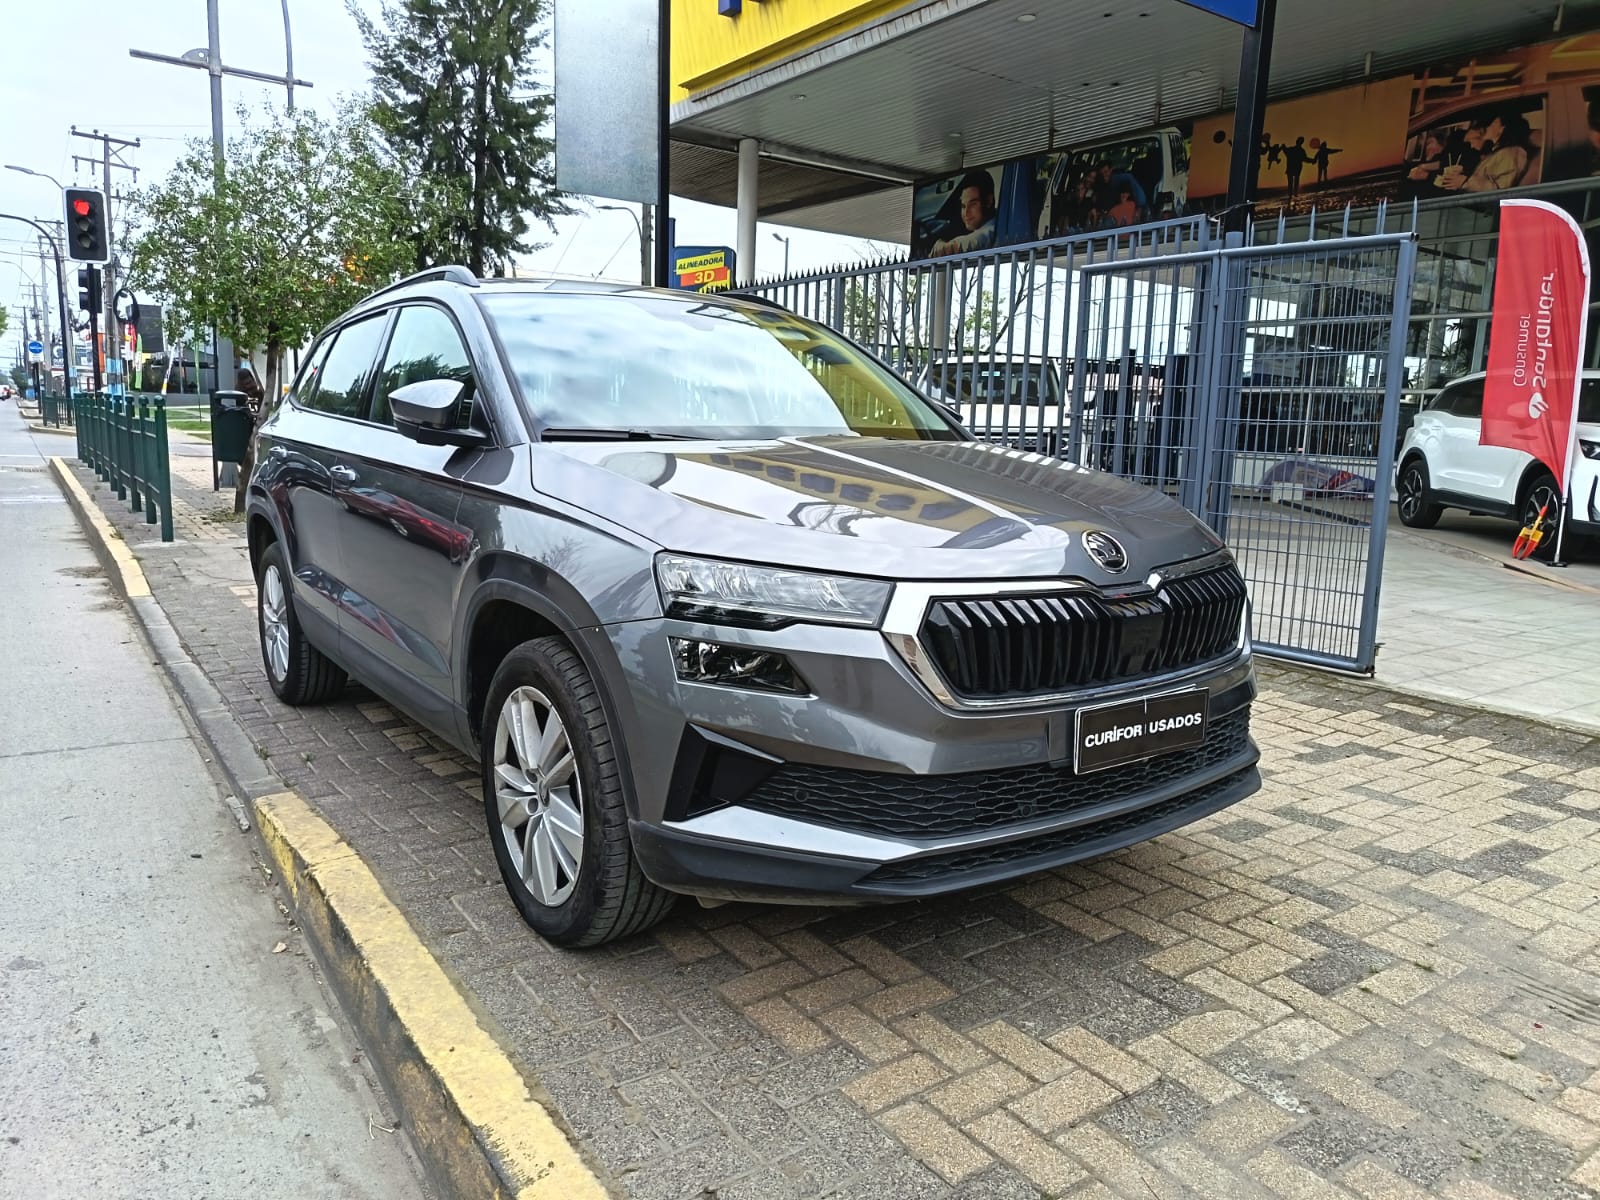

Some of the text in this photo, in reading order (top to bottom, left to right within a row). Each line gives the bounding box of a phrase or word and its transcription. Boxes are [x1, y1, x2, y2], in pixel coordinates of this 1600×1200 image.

[678, 257, 723, 270] ALINEADORA
[694, 270, 715, 284] 3D
[1149, 712, 1202, 734] USADOS
